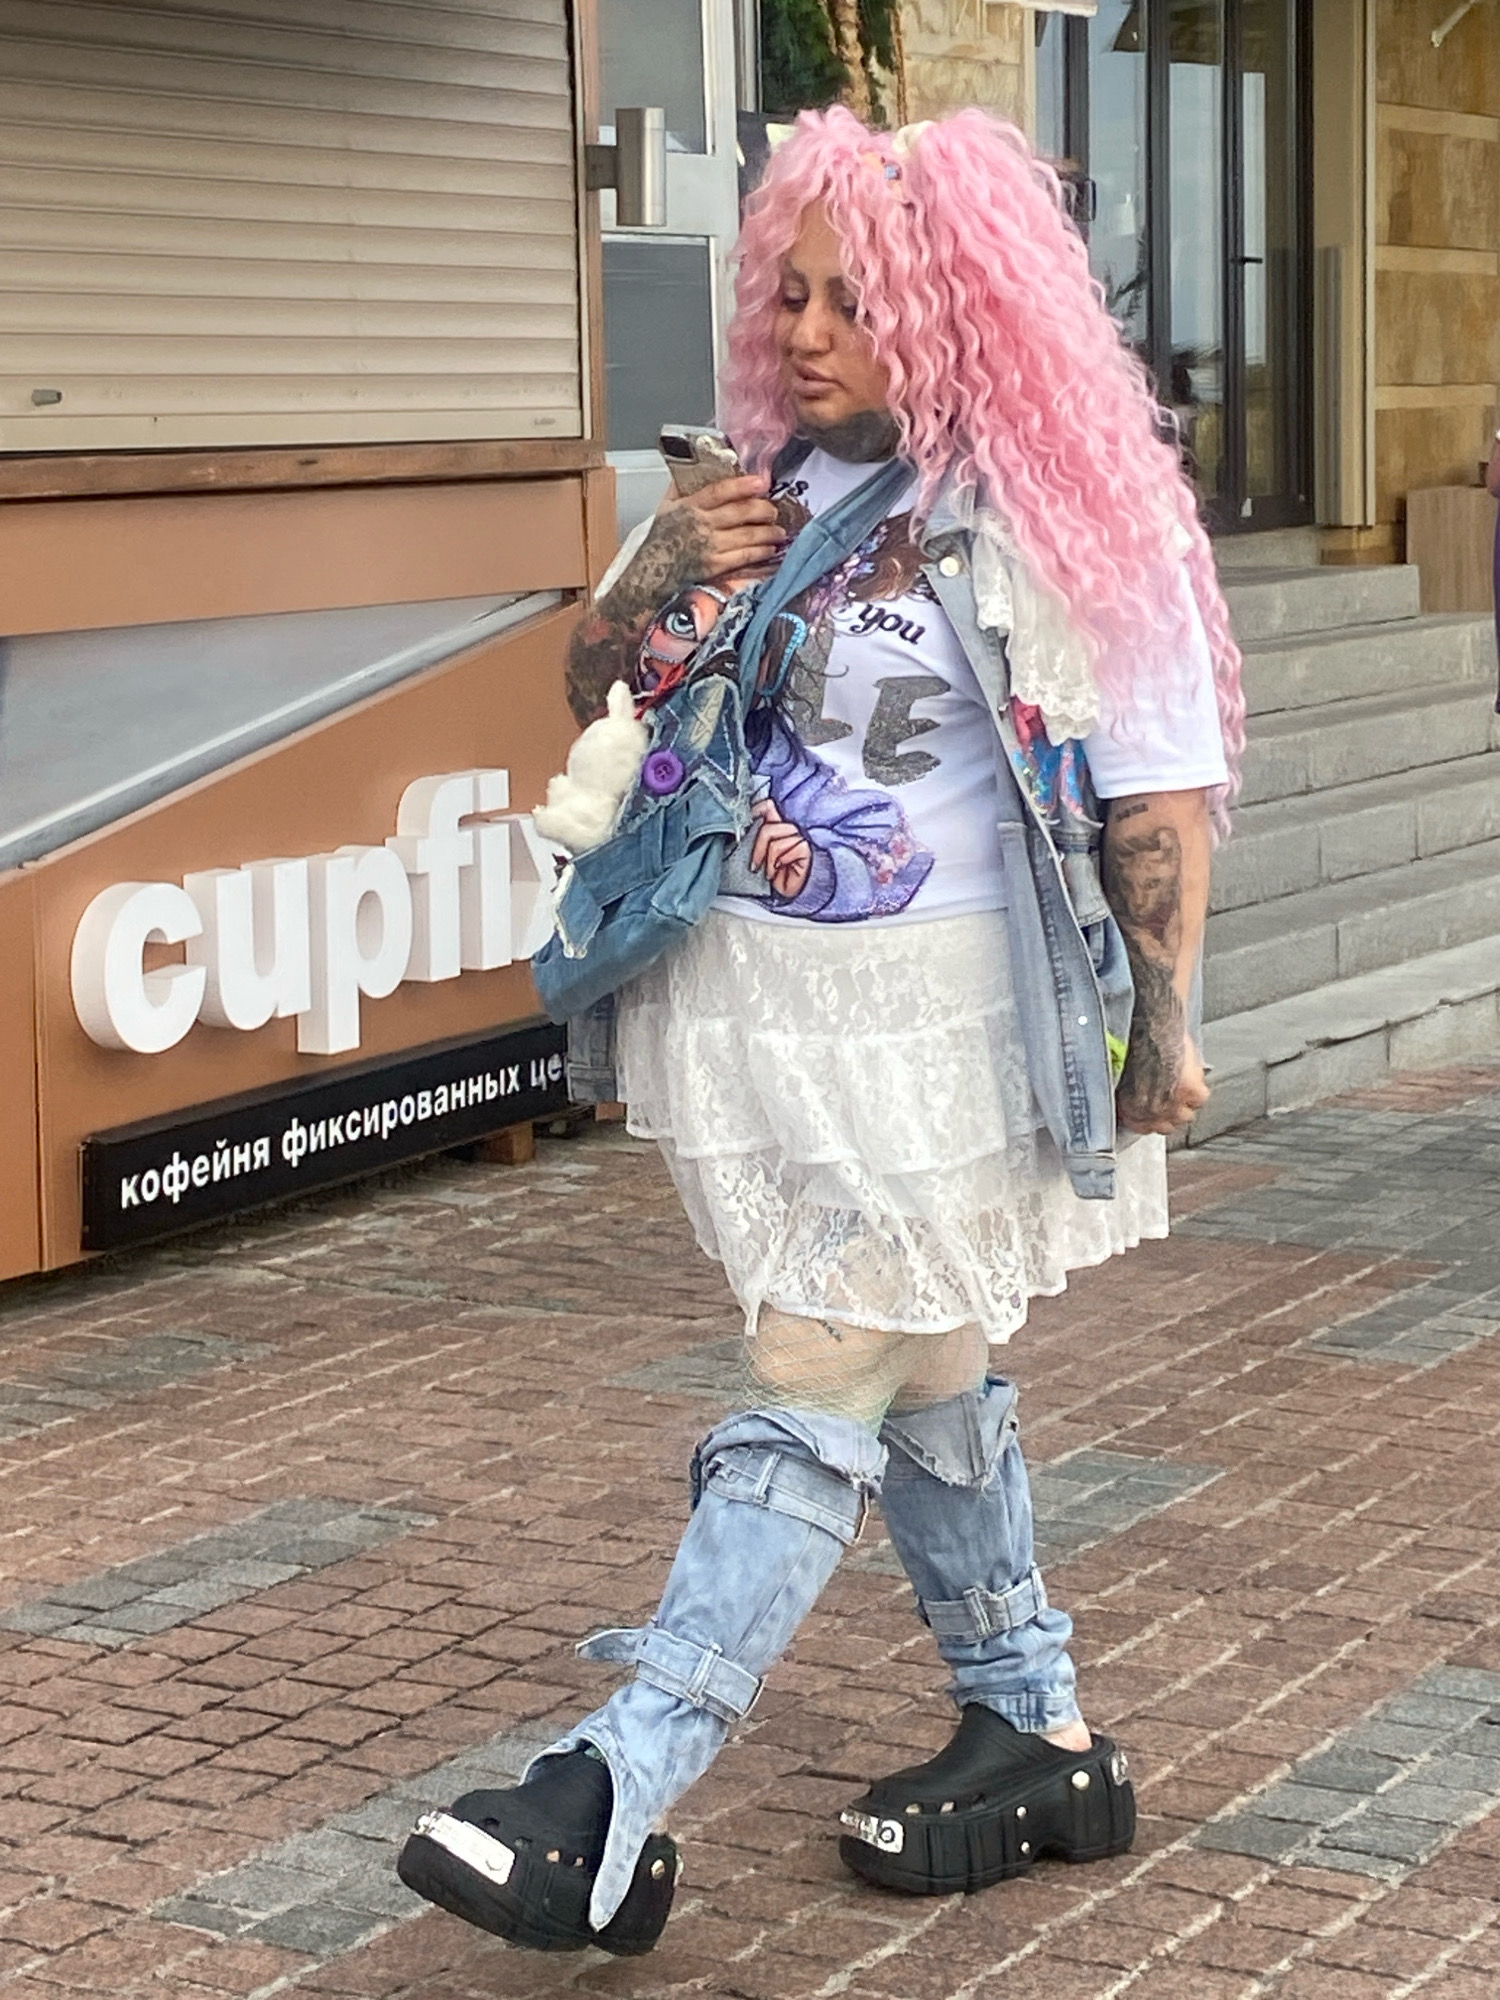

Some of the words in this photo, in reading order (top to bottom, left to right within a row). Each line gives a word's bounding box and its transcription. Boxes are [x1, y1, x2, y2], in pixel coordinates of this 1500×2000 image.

[849, 603, 926, 646] you
[120, 1136, 271, 1210] кофейня
[282, 1063, 521, 1168] фиксированных
[530, 1052, 567, 1091] це
